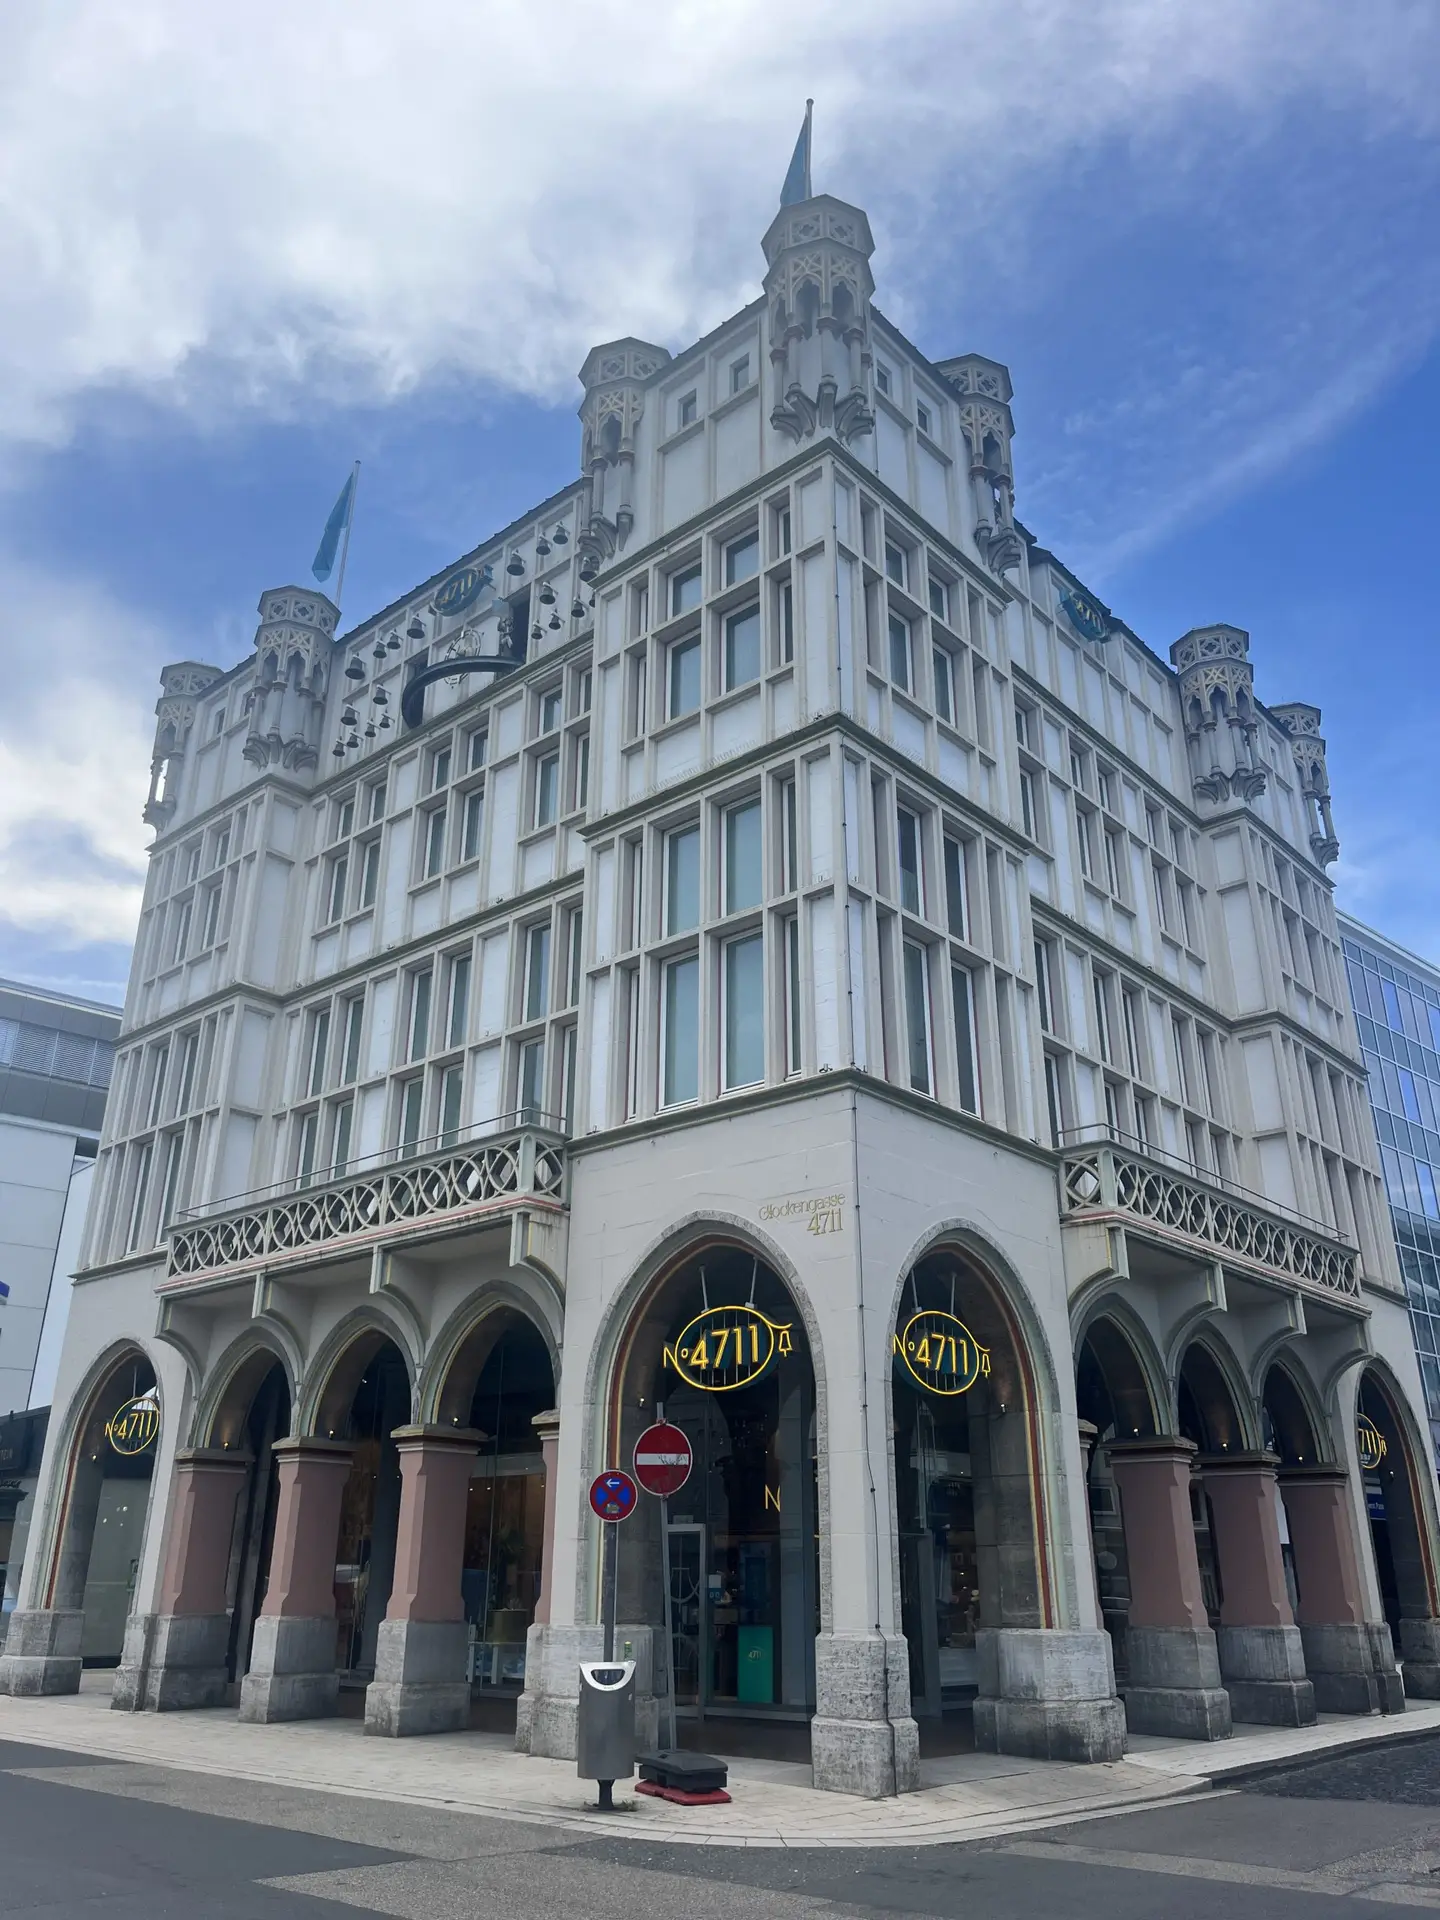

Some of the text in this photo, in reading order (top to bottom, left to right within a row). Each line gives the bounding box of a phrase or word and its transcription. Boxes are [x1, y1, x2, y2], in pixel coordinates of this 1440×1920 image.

[758, 1193, 847, 1221] Glockengasse
[806, 1208, 844, 1236] 4711
[689, 1323, 760, 1370] 4711
[914, 1332, 969, 1376] 4711
[117, 1411, 153, 1440] 4711
[1357, 1427, 1378, 1455] 711
